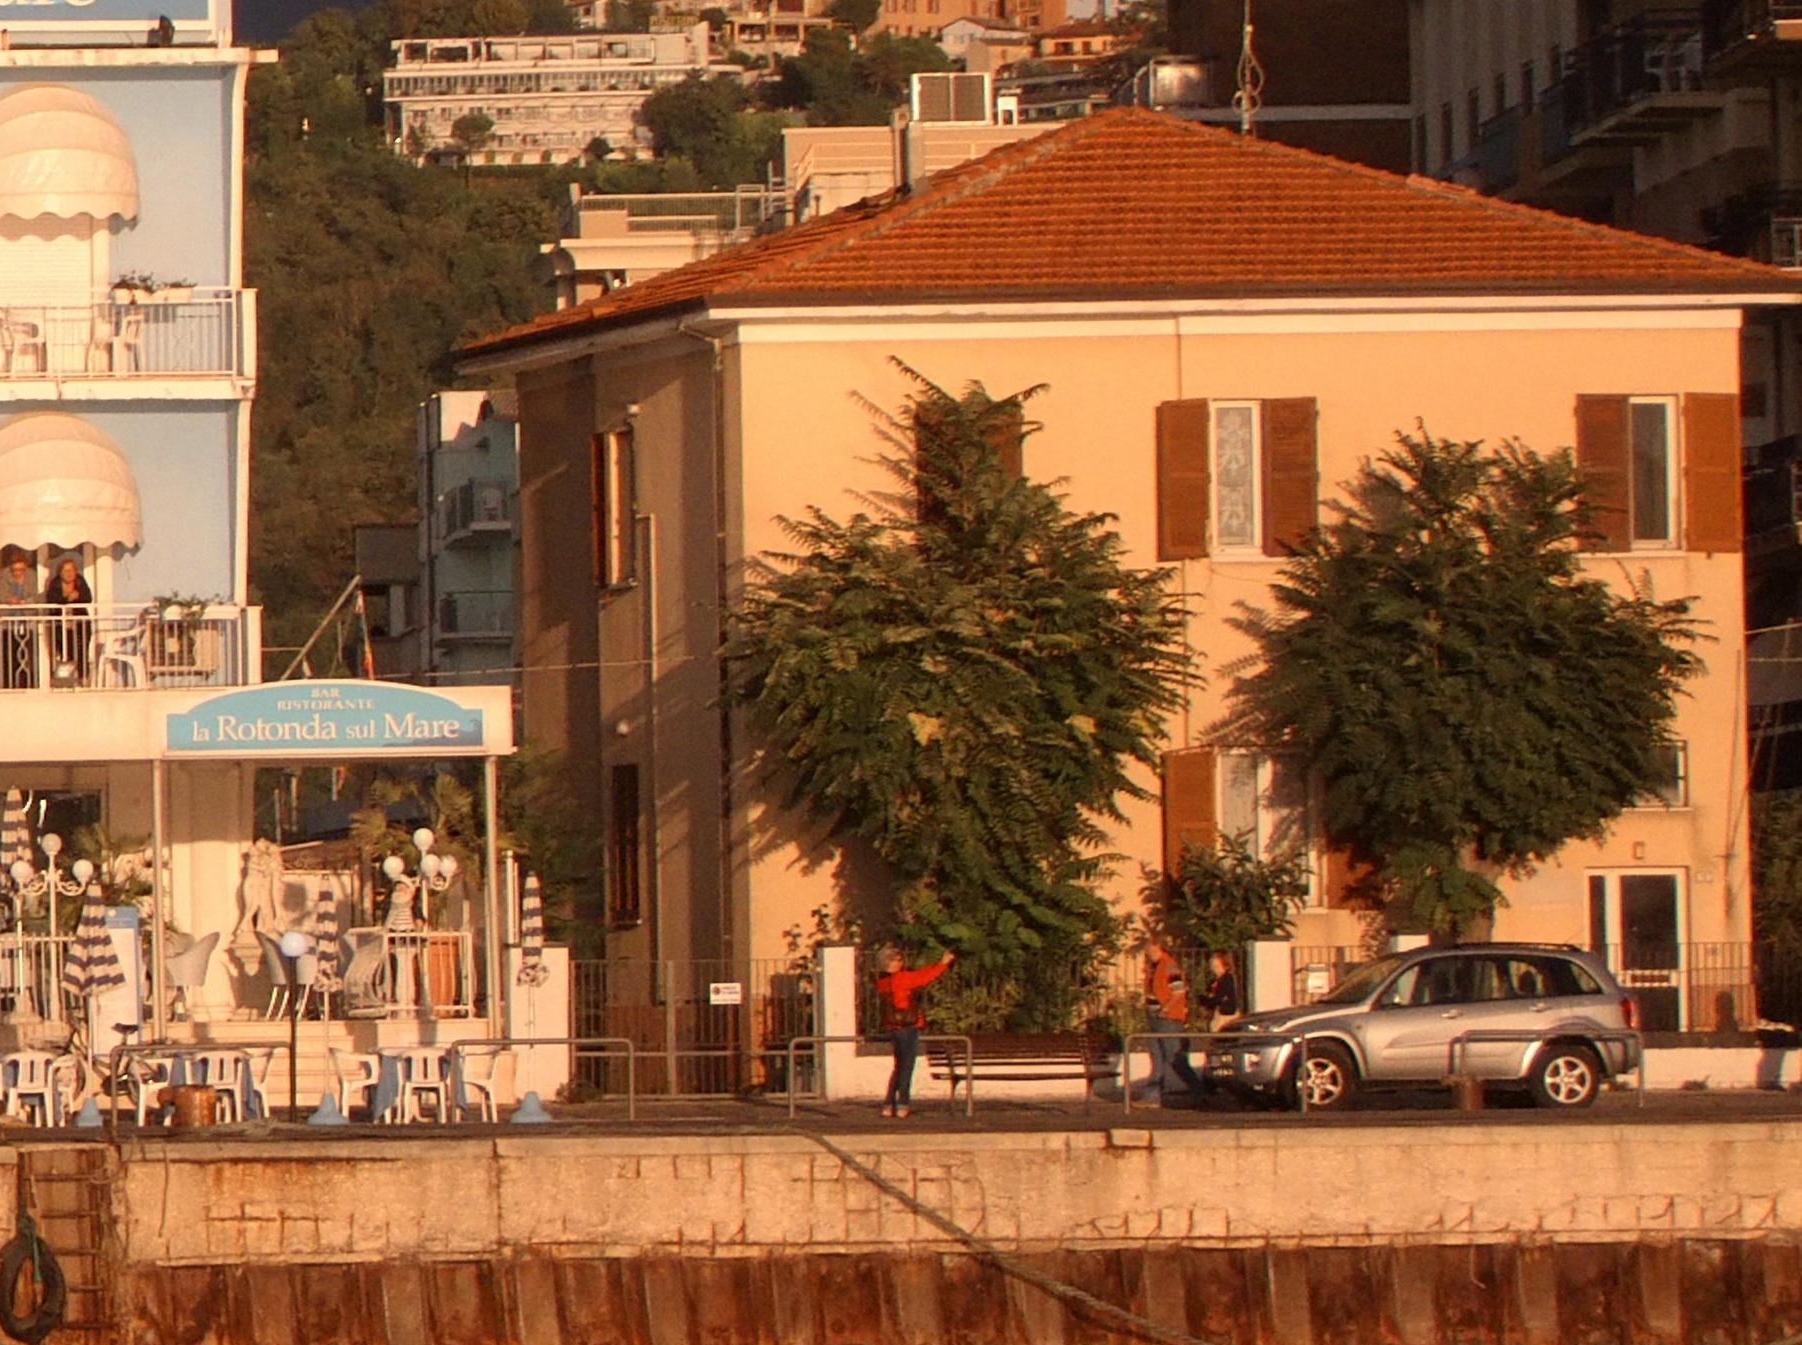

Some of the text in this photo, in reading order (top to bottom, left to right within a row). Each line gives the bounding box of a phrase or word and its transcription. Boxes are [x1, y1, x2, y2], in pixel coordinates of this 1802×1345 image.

[311, 687, 340, 698] BAR
[277, 699, 375, 711] RISTORANTE
[193, 712, 460, 742] la Rotonda sul Mare
